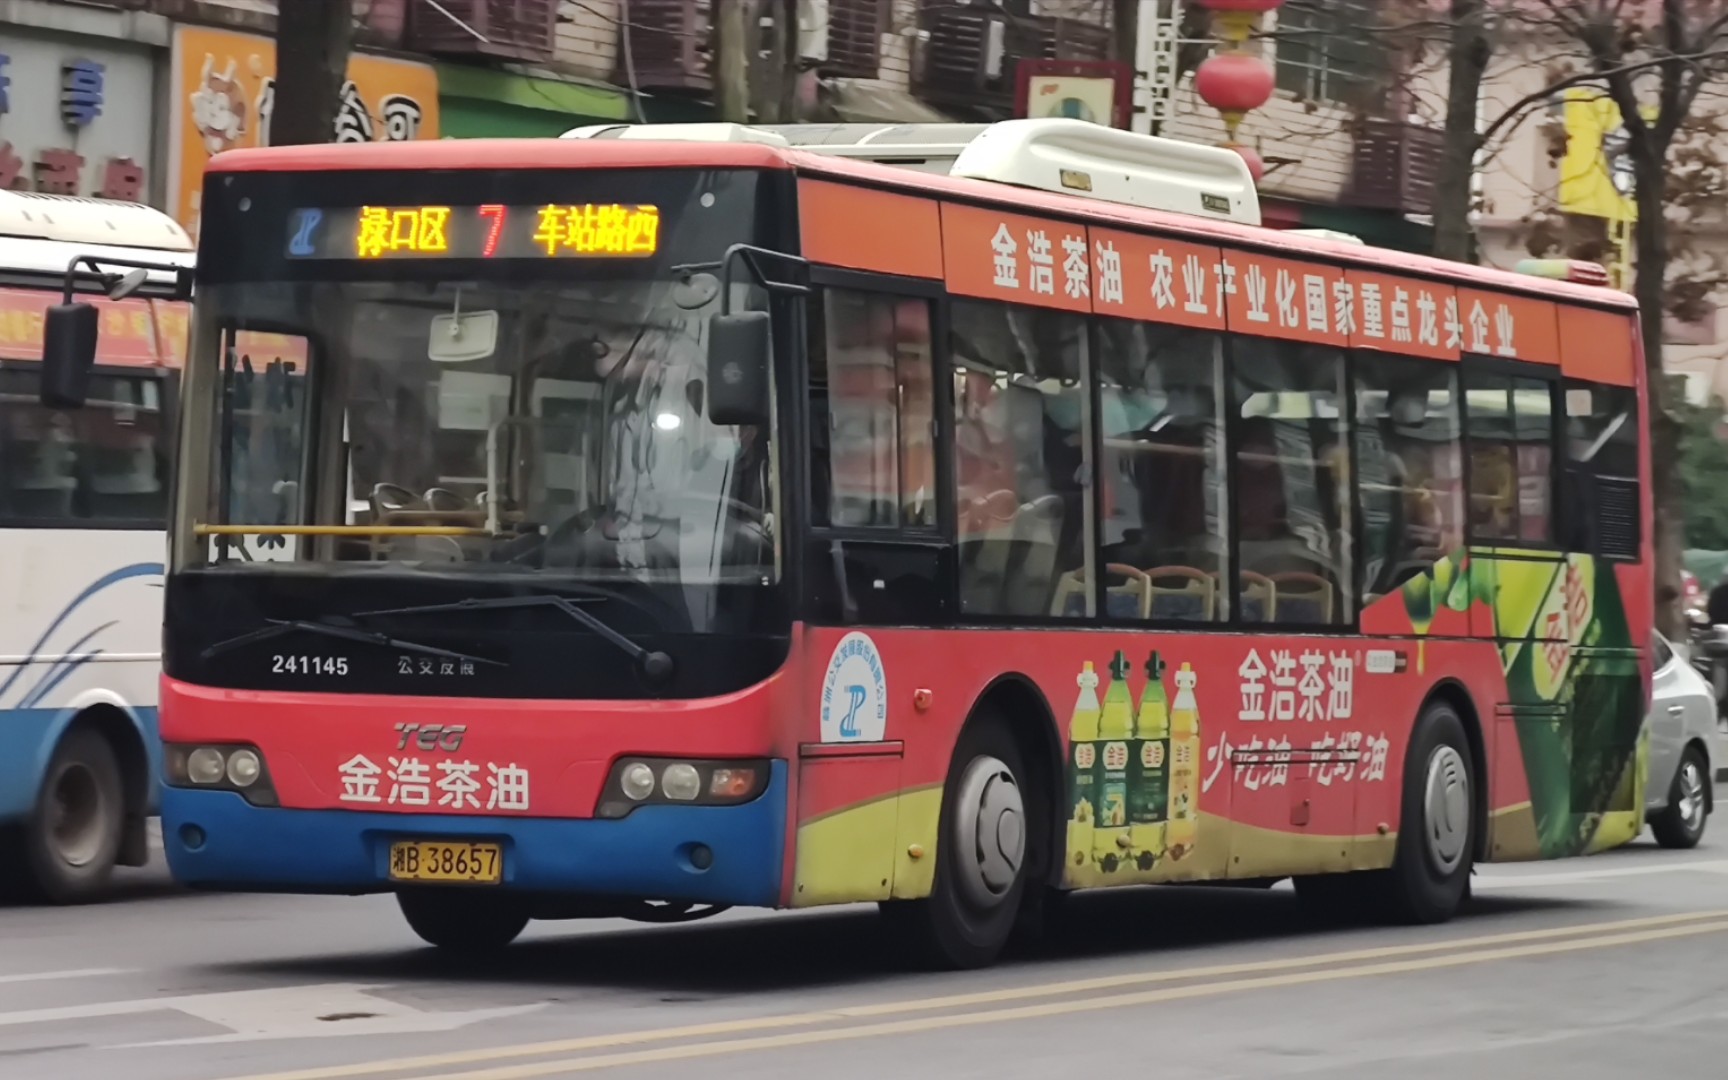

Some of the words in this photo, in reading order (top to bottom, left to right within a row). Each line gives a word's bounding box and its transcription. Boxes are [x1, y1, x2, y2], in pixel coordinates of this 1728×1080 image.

[479, 204, 506, 257] 7
[533, 203, 658, 255] 车站路西
[991, 223, 1123, 305] 金浩茶油
[1150, 249, 1517, 357] 农业产业化国家重点龙头企业
[272, 654, 349, 676] 241145
[1238, 648, 1354, 722] 金浩茶油
[394, 722, 468, 752] TEG
[1202, 731, 1292, 792] 少吃油
[1308, 731, 1390, 787] 吃好油
[338, 753, 530, 811] 金浩茶油
